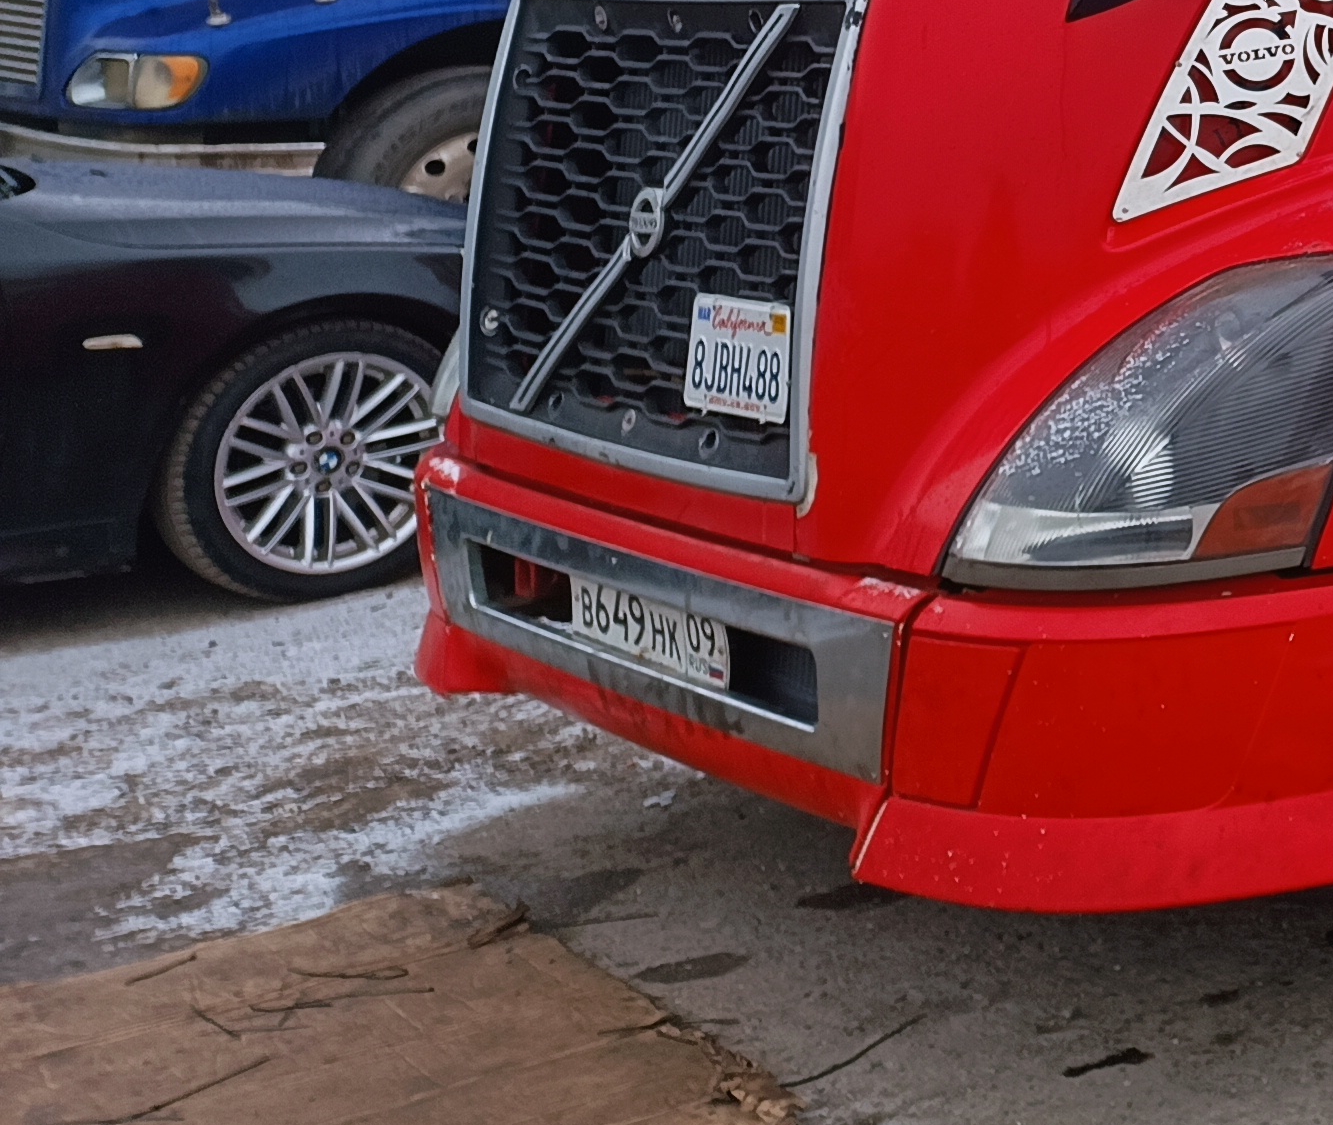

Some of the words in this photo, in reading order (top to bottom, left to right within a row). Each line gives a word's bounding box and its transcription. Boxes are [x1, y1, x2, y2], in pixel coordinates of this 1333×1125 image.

[1218, 42, 1296, 67] VOLVO
[711, 305, 773, 340] California
[691, 337, 781, 404] 8JBH488
[685, 613, 716, 658] 09
[688, 654, 710, 676] RUS
